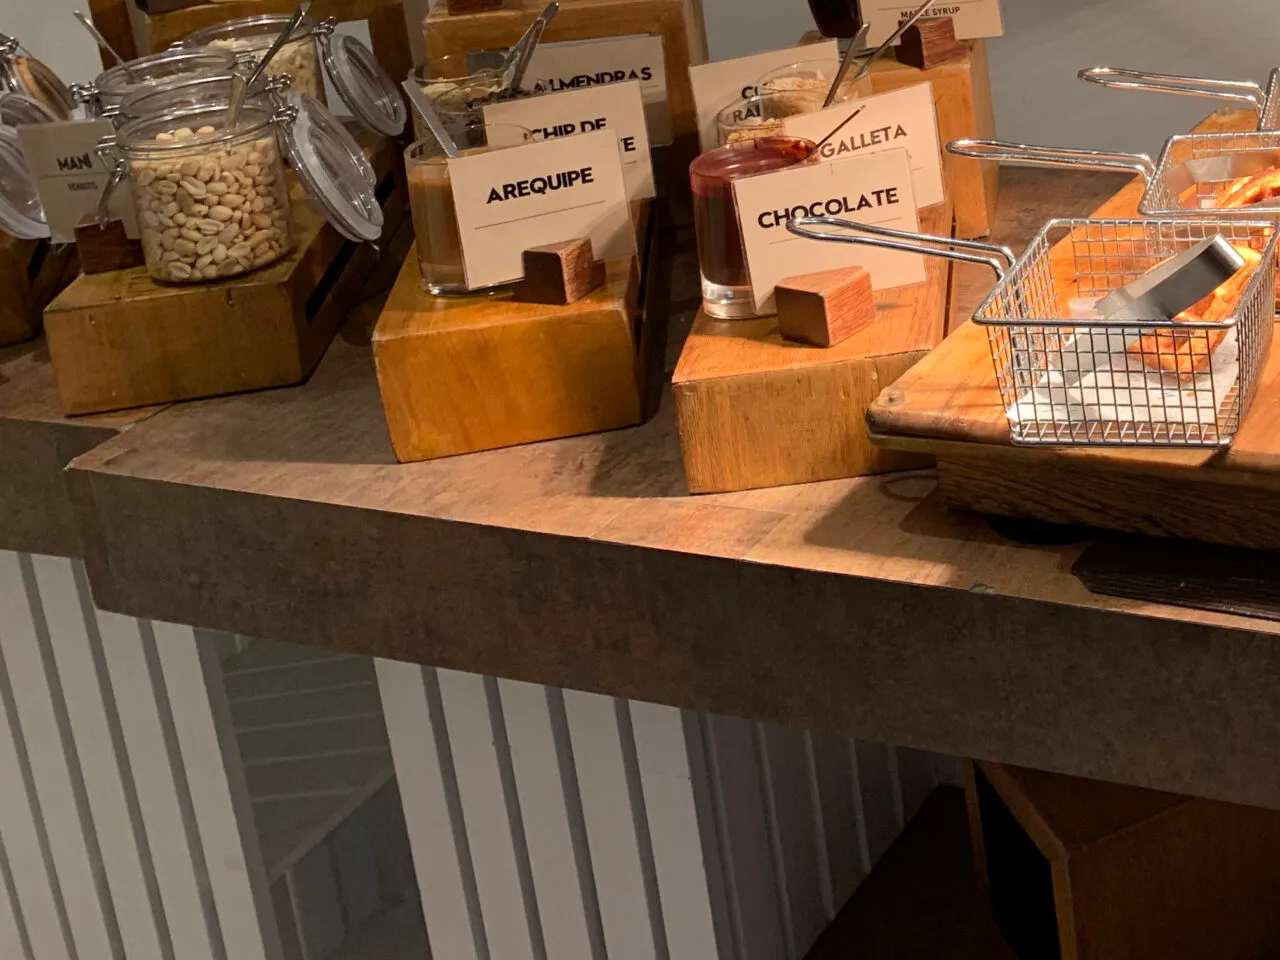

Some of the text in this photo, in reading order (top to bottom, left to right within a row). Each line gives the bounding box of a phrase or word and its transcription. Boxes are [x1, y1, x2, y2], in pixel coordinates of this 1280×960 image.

[932, 6, 960, 16] SYRUP
[533, 66, 653, 93] ALMENDRAS
[820, 124, 908, 159] GALLETA
[486, 166, 594, 204] AREQUIPE
[757, 187, 900, 229] CHOCOLATE
